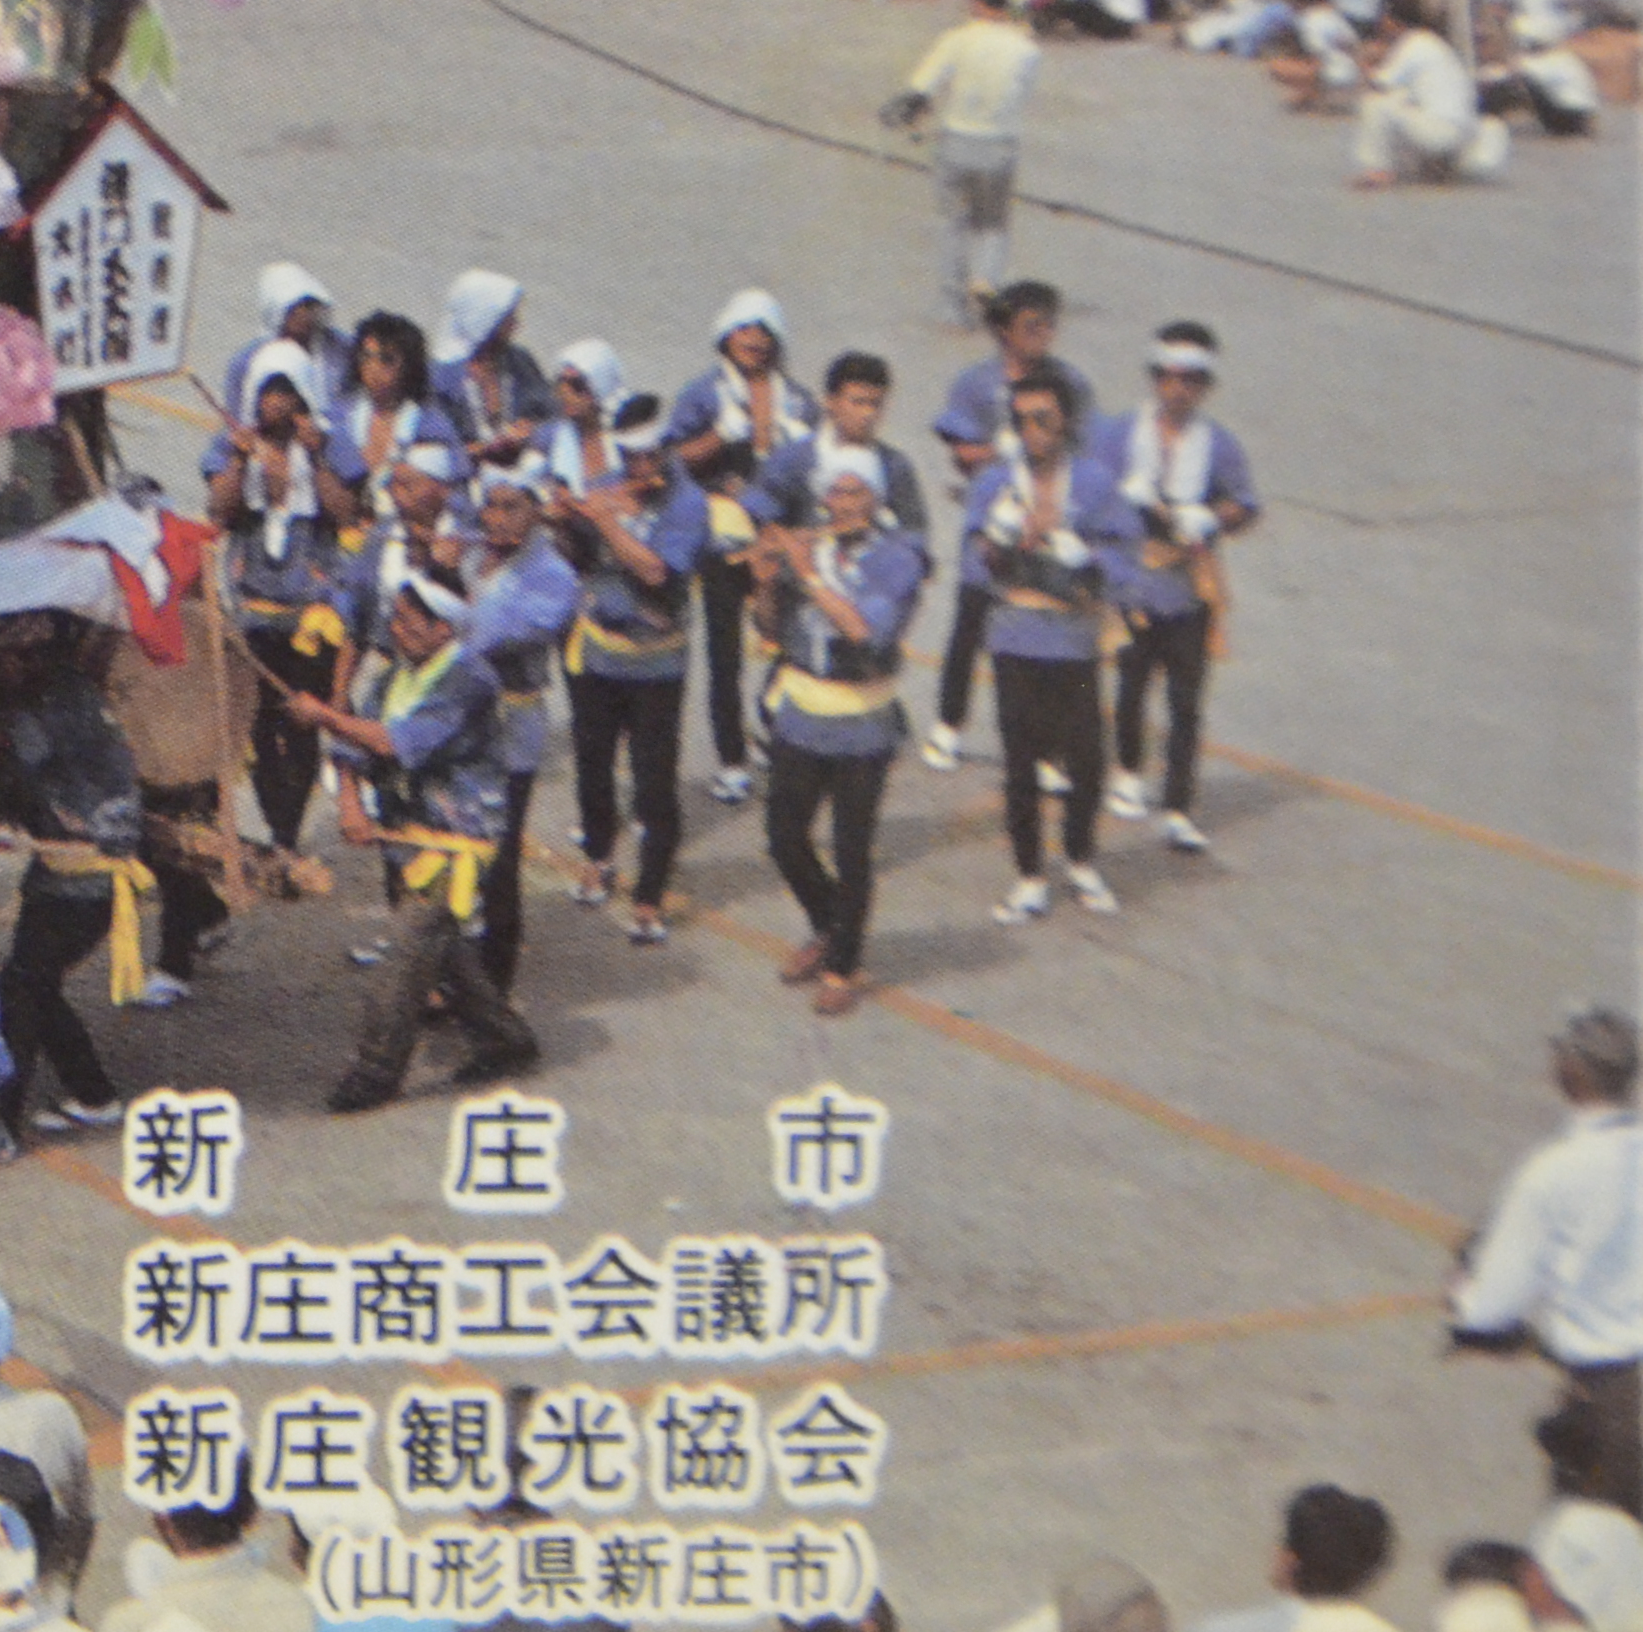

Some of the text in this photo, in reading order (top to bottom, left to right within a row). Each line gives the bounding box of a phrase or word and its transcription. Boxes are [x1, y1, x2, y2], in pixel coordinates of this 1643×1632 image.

[131, 1246, 879, 1346] 新庄商工会議所
[131, 1393, 879, 1496] 新庄観光協会
